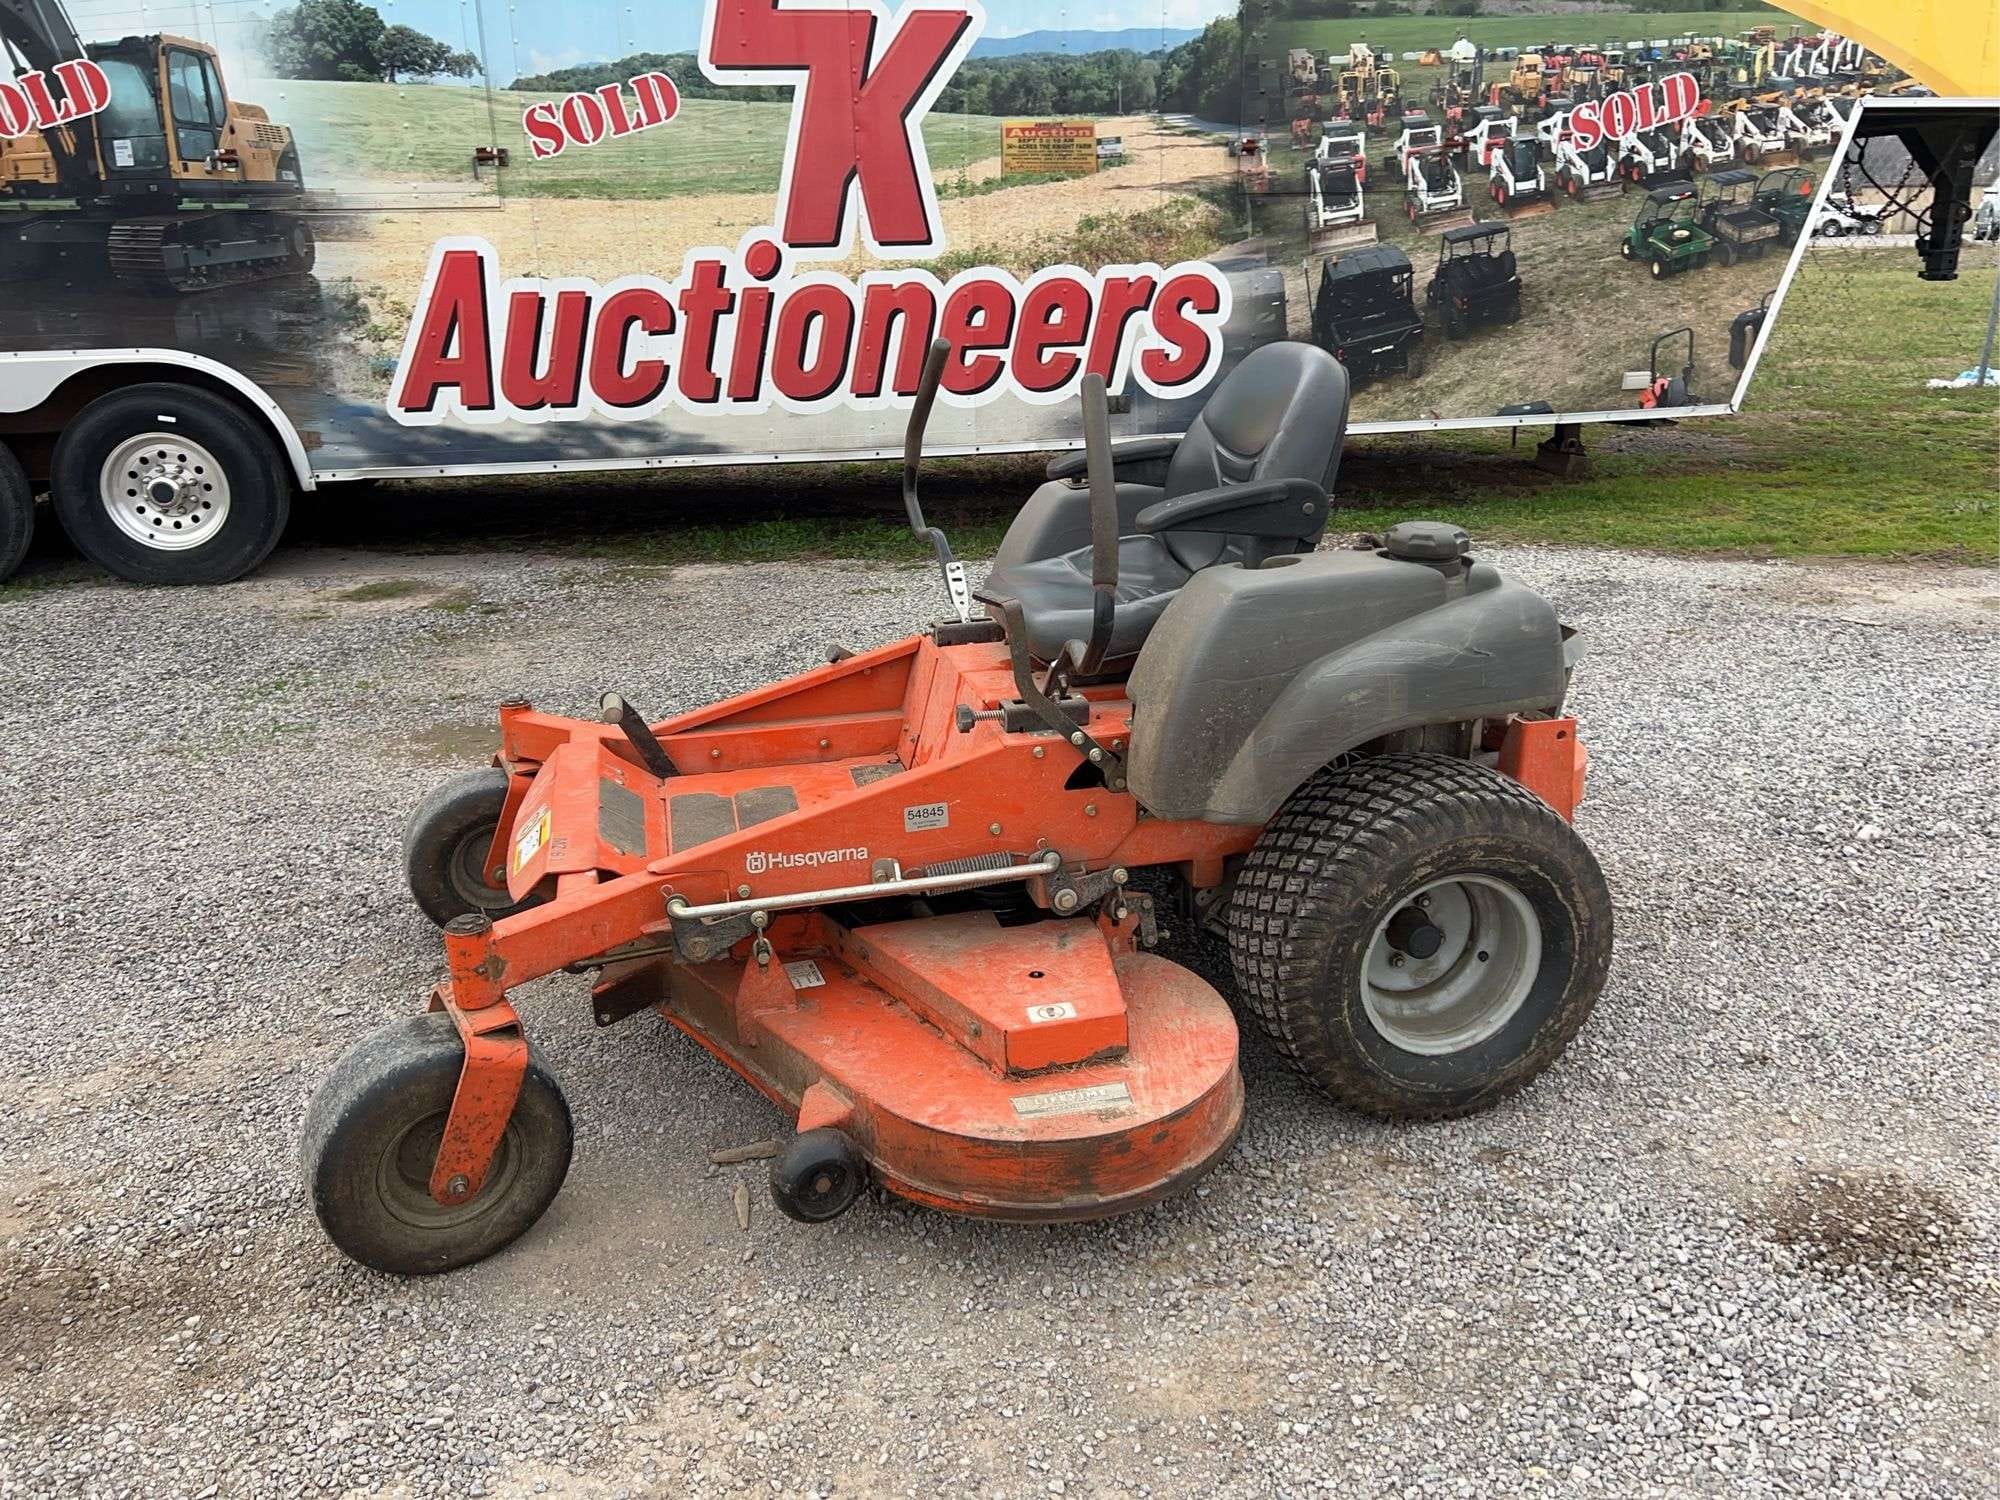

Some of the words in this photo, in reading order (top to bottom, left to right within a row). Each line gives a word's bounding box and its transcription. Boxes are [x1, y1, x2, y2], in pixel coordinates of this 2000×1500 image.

[0, 61, 109, 137] OLD
[525, 74, 678, 158] SOLD
[1009, 128, 1091, 138] Auction
[1571, 75, 1697, 150] SOLD
[398, 239, 1221, 412] Auctioneers
[907, 806, 945, 821] 54845
[768, 846, 869, 869] Husqvarna
